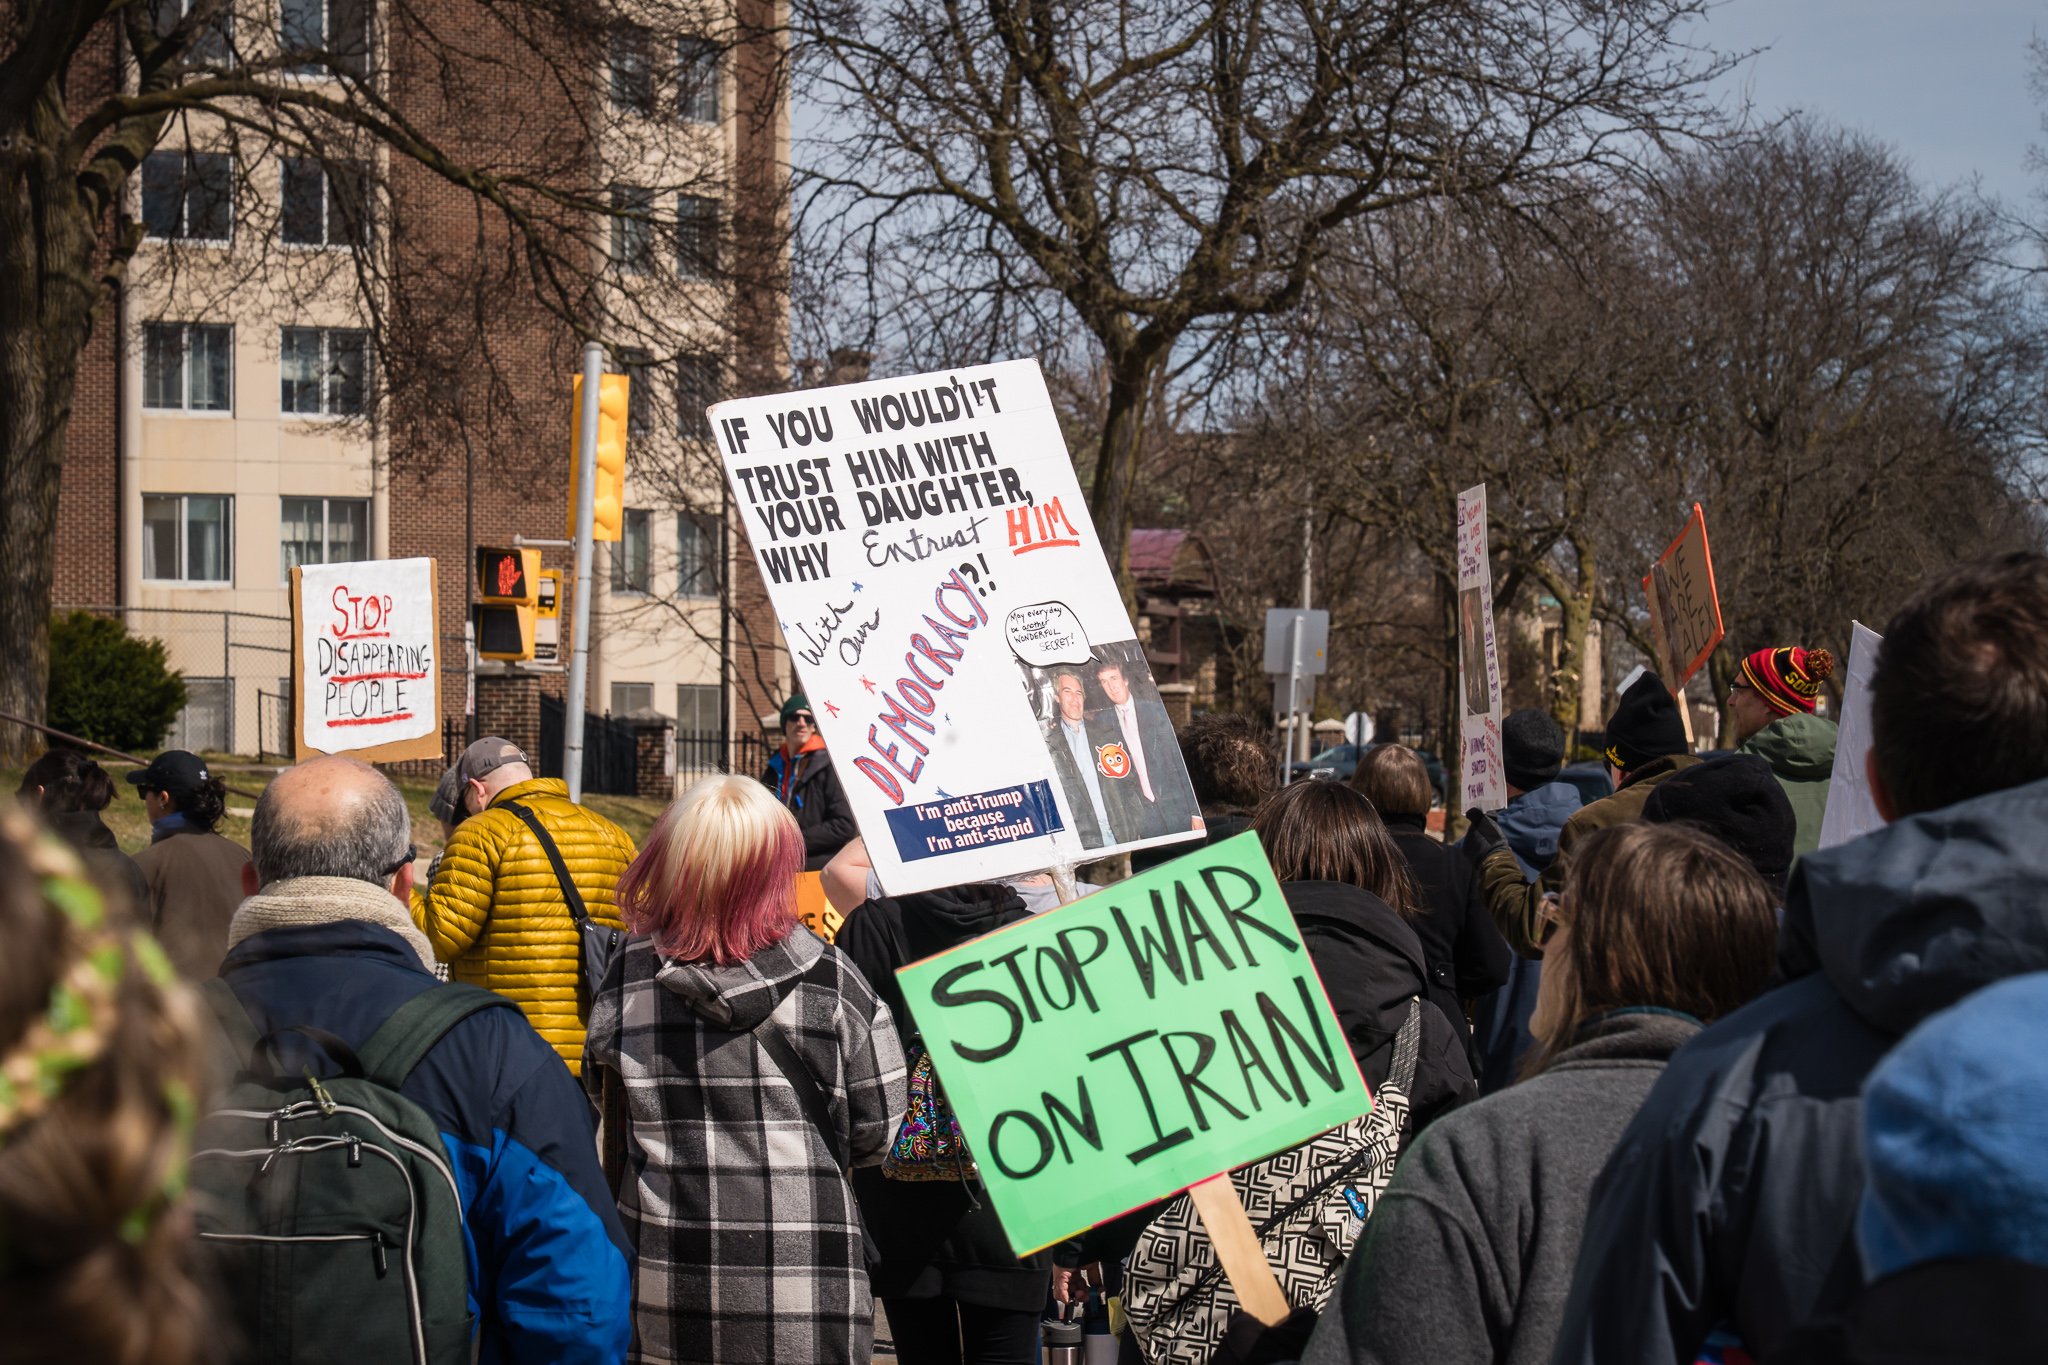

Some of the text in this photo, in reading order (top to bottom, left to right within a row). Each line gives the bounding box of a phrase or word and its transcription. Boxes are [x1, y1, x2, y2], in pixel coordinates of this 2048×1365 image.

[721, 417, 750, 454] IF
[766, 406, 833, 449] YOU
[735, 431, 997, 504] TRUST HIM WITH
[755, 466, 1034, 541] YOUR DAUGHTER,
[760, 496, 1080, 584] WHY Entrust HIM
[1662, 544, 1690, 597] WE
[332, 585, 393, 637] STOP
[1010, 613, 1025, 624] May
[1669, 579, 1698, 626] ARE
[1014, 628, 1061, 643] WONDERFUL
[1022, 619, 1050, 631] another
[1039, 632, 1075, 652] SECRET!
[318, 638, 431, 676] DISAPPEARING
[325, 680, 408, 718] PEOPLE
[915, 790, 1023, 821] I'm anti-Trump
[944, 810, 1006, 832] because
[926, 818, 1035, 852] I'm anti-stupid
[930, 866, 1299, 1063] STOP WAR
[988, 976, 1344, 1180] ON IRAN
